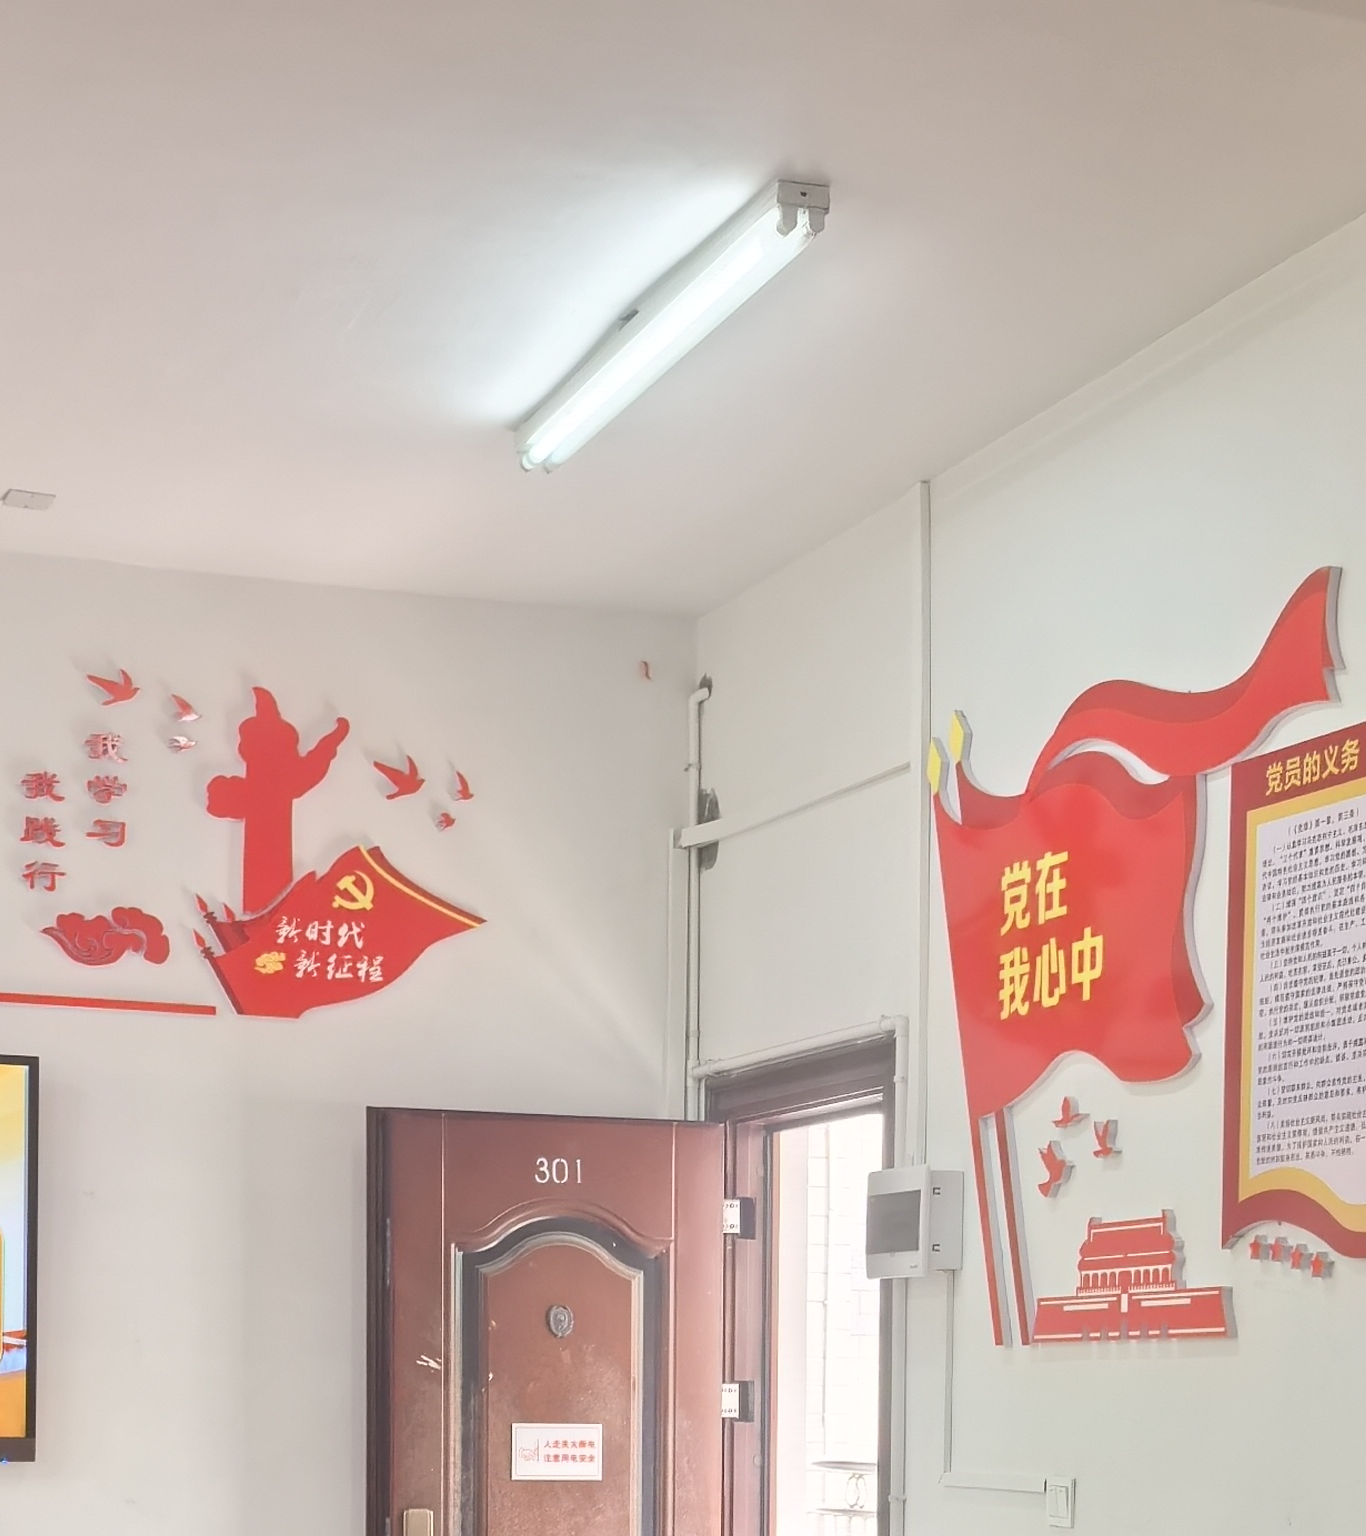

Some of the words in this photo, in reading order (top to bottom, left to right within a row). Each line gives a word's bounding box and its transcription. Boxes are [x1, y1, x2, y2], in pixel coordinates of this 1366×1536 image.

[84, 731, 128, 847] 我学习
[1265, 738, 1360, 797] 党员的义务
[19, 770, 66, 892] 我践行
[1000, 851, 1069, 936] 党在
[275, 915, 366, 950] 新时代
[293, 951, 385, 983] 新征程
[998, 926, 1105, 1021] 我心中
[535, 1157, 583, 1184] 301
